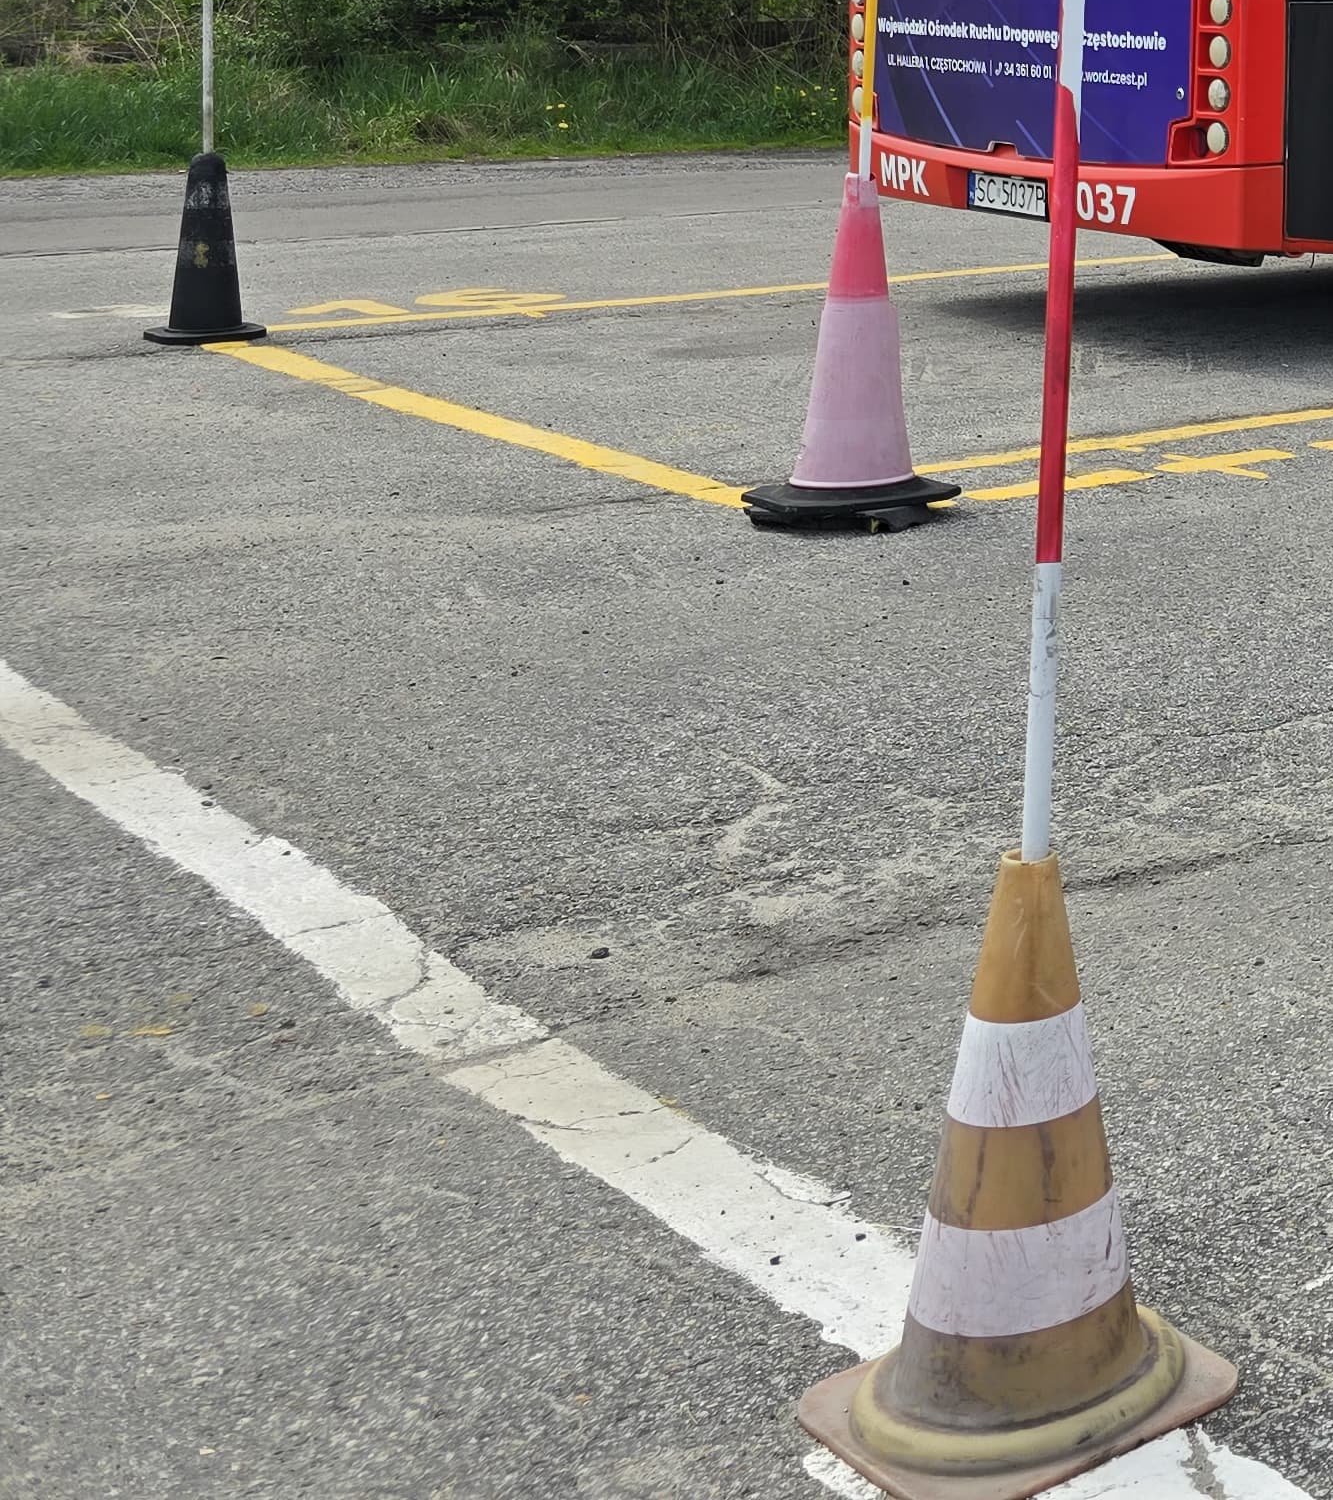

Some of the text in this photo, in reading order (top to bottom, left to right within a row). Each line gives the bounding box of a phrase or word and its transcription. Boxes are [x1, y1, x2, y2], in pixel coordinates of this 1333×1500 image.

[878, 15, 928, 38] Wojewódzki
[928, 21, 969, 39] Ośrodek
[969, 23, 1001, 40] Ruchu
[1003, 25, 1059, 49] Drogoweg
[896, 54, 924, 69] HALLERA
[931, 58, 987, 74] CZĘSTOCHOWA
[1004, 63, 1015, 76] 34
[1015, 63, 1029, 77] 361
[1030, 64, 1041, 78] 60
[1043, 66, 1052, 79] 01
[1082, 69, 1148, 90] .word.czest.pl
[880, 152, 930, 197] MPK
[976, 176, 1045, 210] SC 5037P
[1076, 181, 1136, 225] 037
